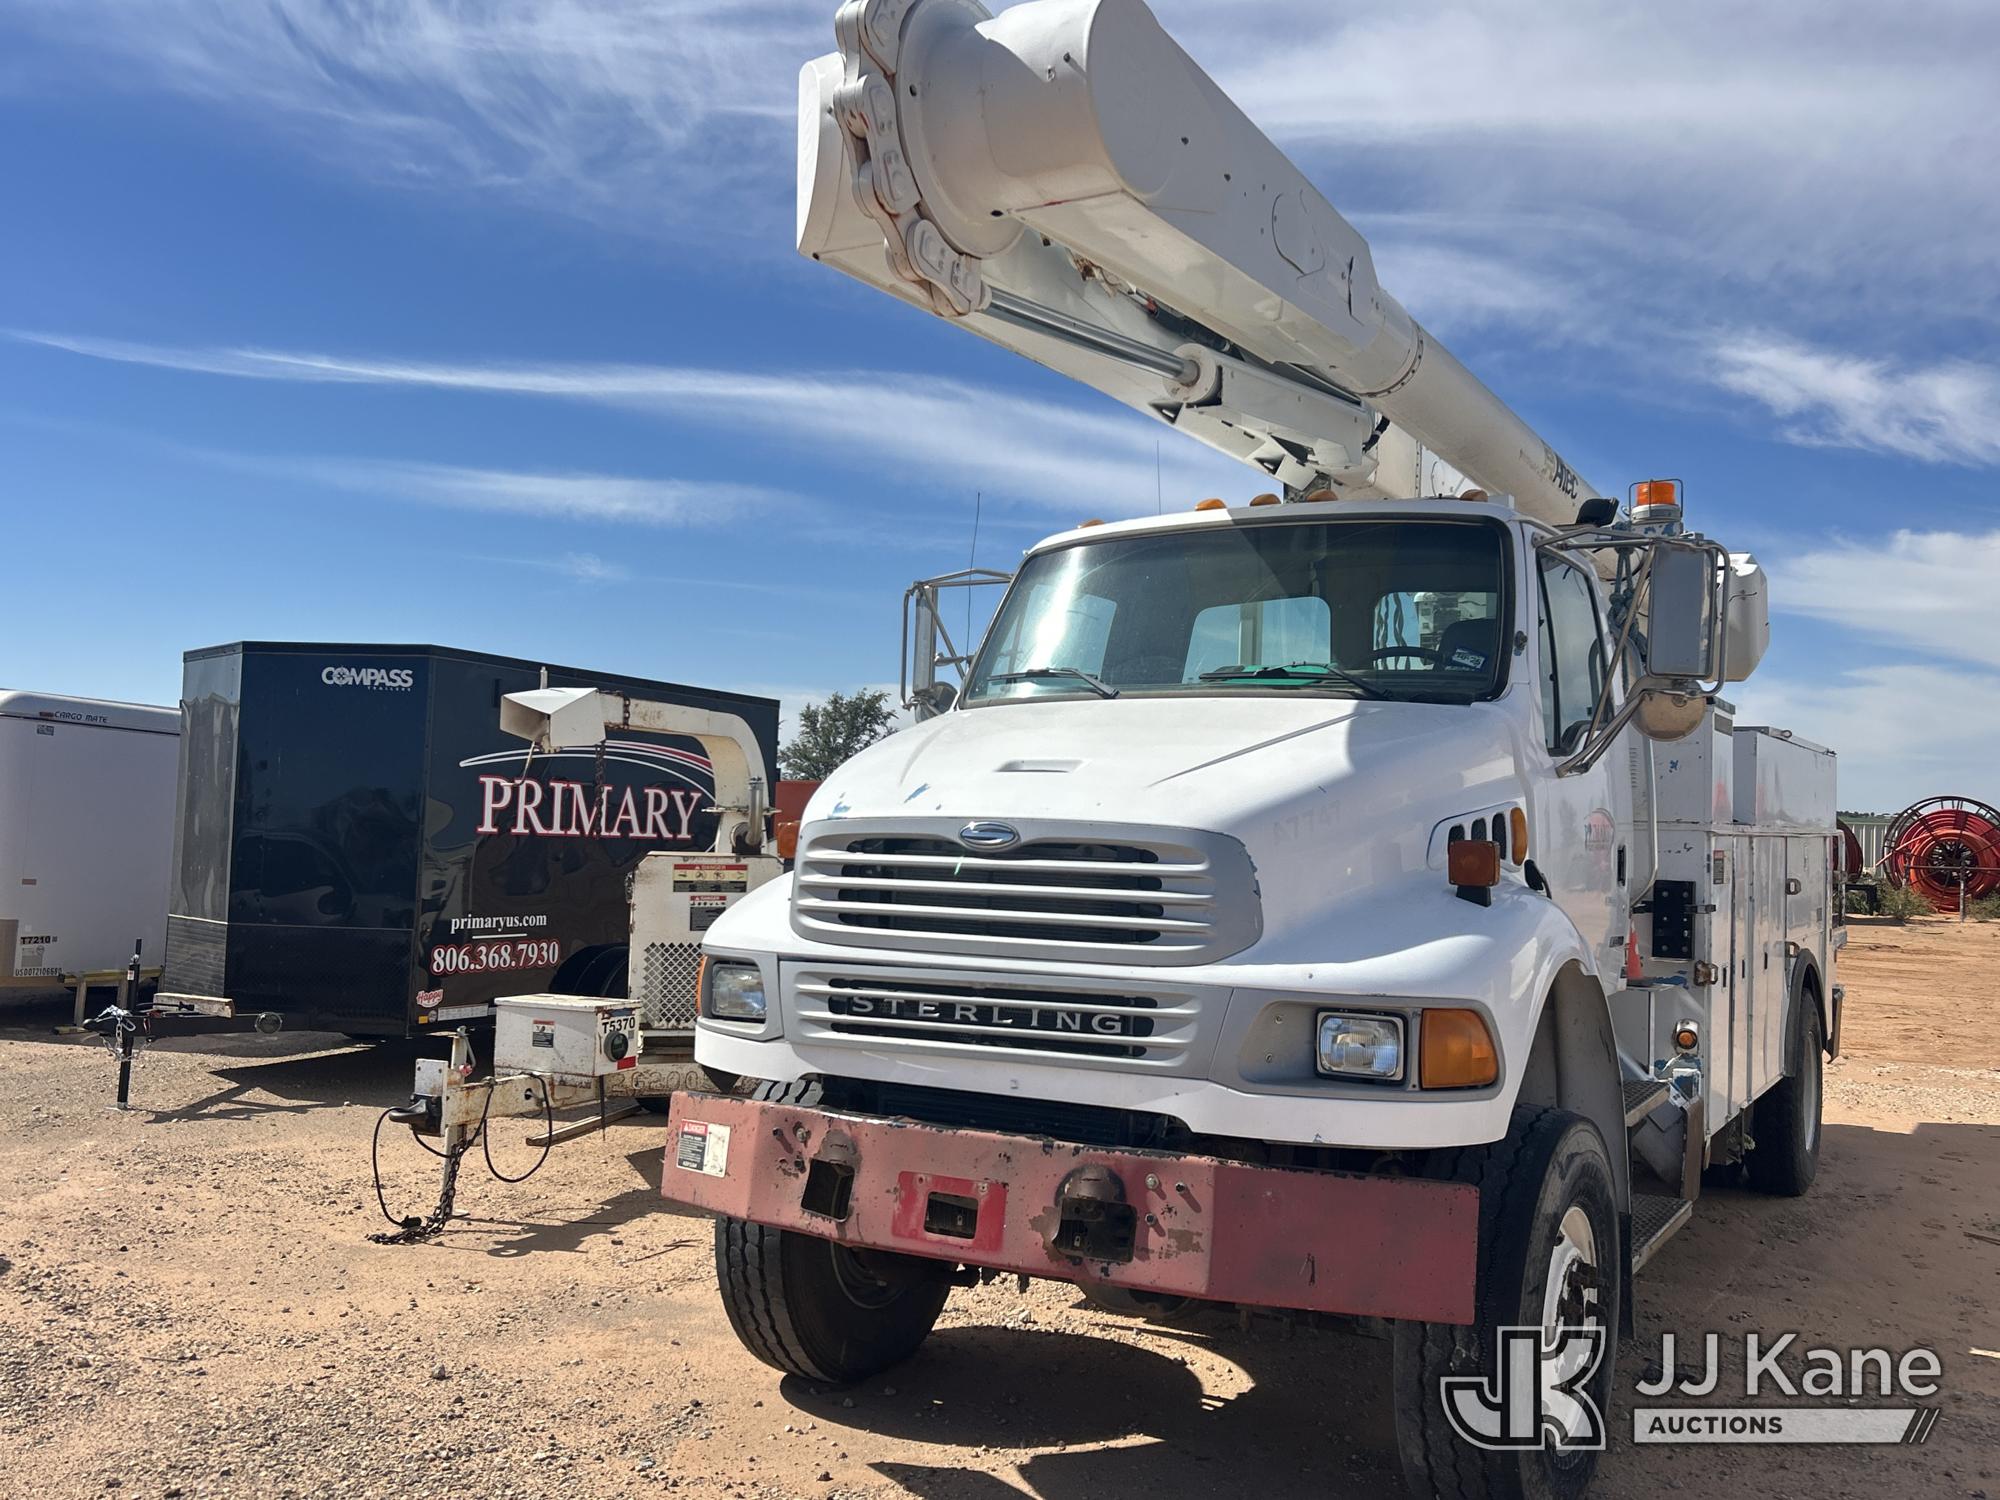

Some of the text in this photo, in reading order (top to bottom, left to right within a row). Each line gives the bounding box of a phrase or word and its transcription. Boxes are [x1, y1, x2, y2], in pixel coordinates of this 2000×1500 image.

[321, 666, 413, 688] COMPASS
[54, 711, 82, 721] CARGO
[85, 714, 109, 723] MATE
[477, 775, 702, 840] PRIMARY
[450, 913, 548, 934] primaryus.com
[21, 936, 51, 944] T7210
[431, 940, 560, 974] 806.368.7930
[602, 1017, 636, 1034] T5370
[851, 996, 1123, 1035] STERLING
